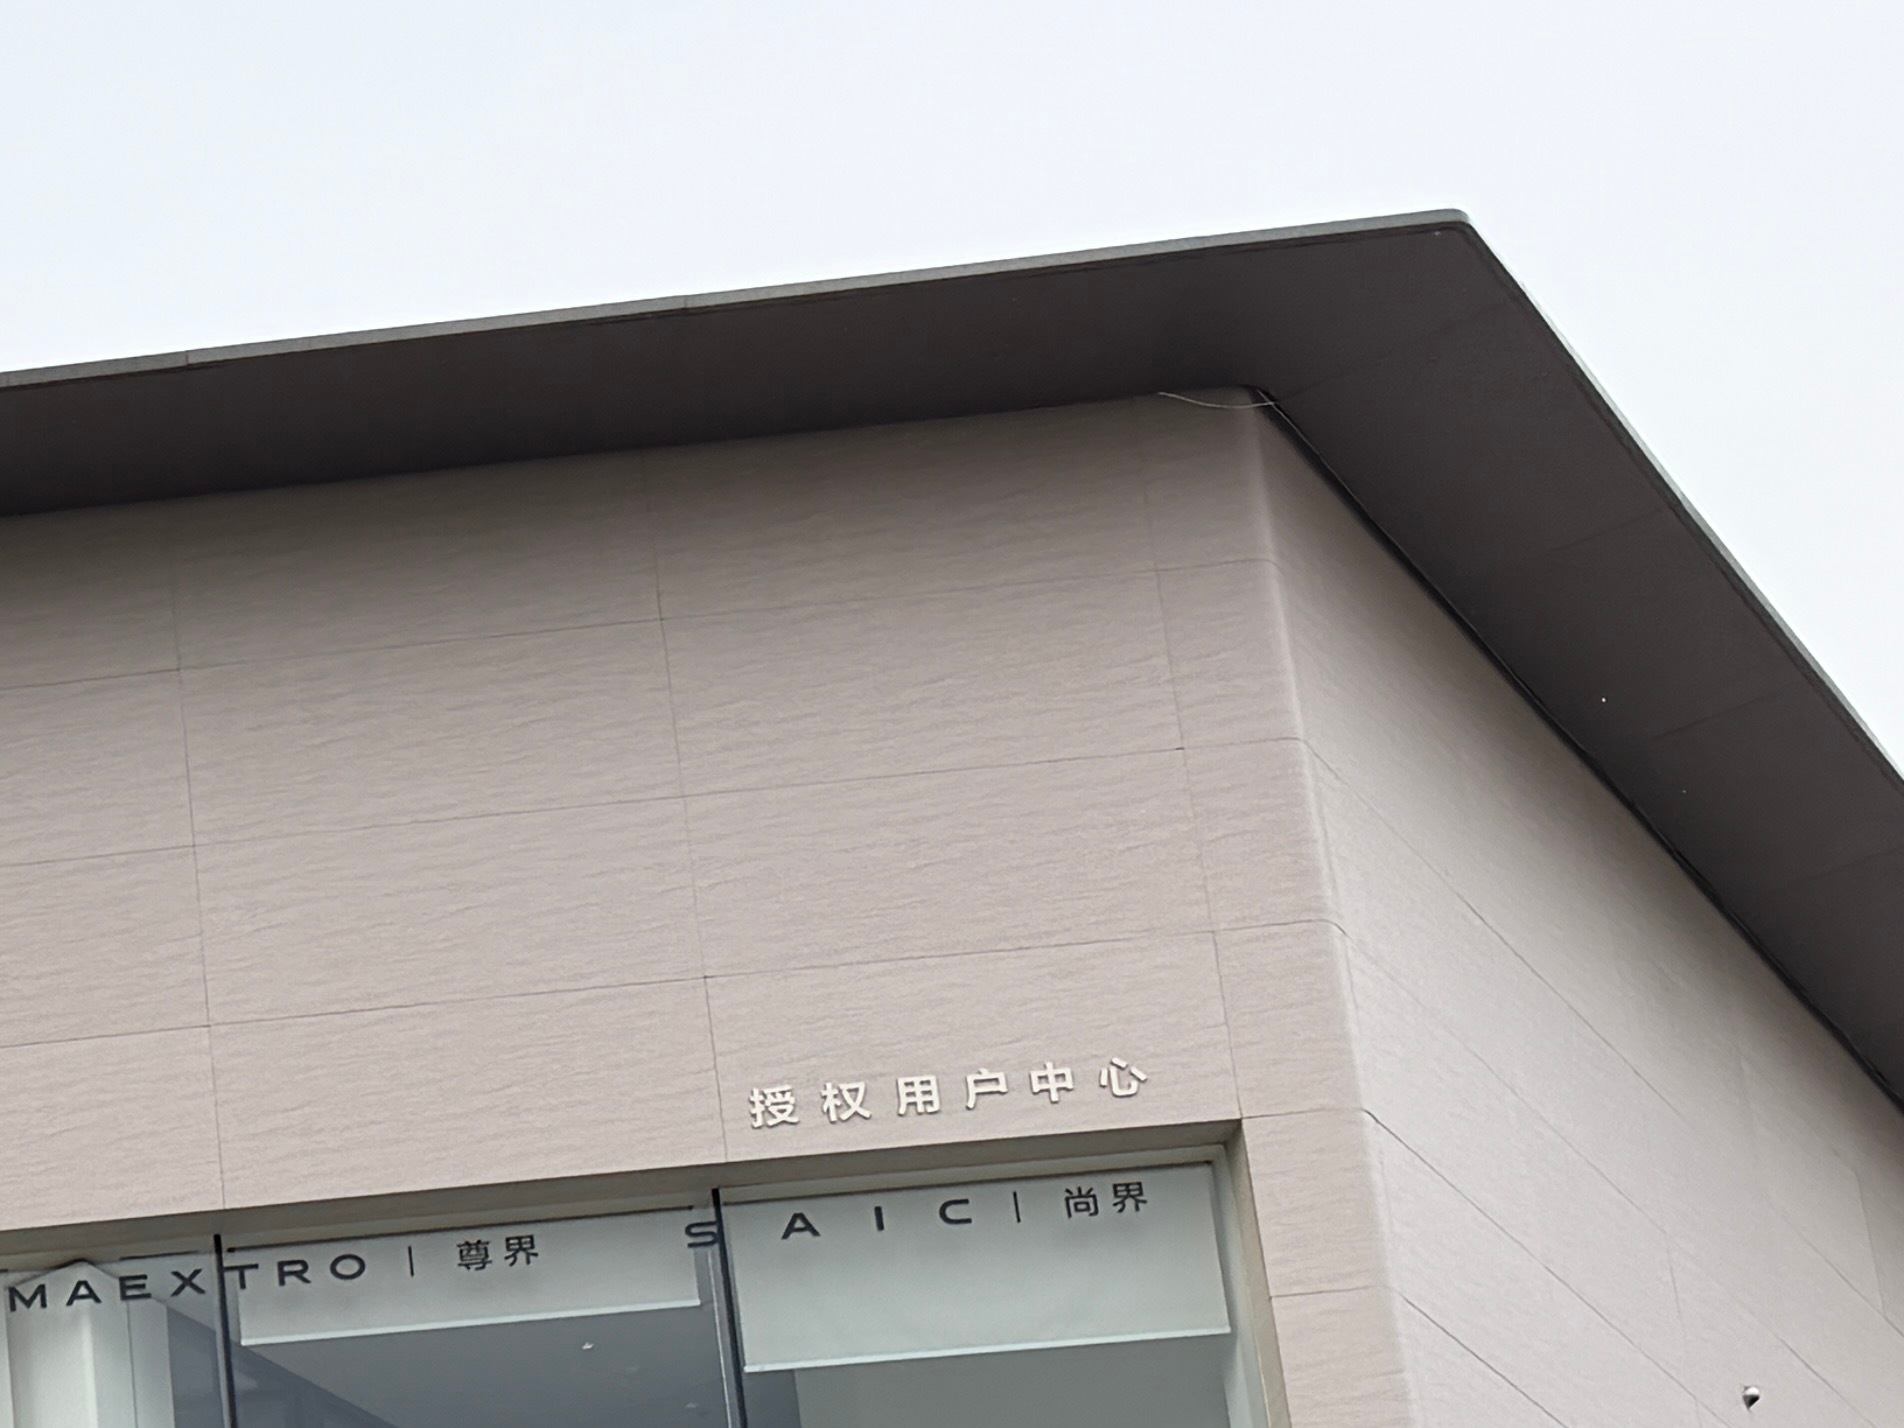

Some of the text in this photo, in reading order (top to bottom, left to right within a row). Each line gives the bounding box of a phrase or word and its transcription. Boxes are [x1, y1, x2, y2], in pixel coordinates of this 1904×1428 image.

[749, 1056, 1148, 1130] 授权用户中心
[684, 1198, 972, 1249] SAIC
[1063, 1181, 1149, 1220] 尚界
[456, 1234, 539, 1272] 尊界
[6, 1252, 367, 1313] MAEXTRO
